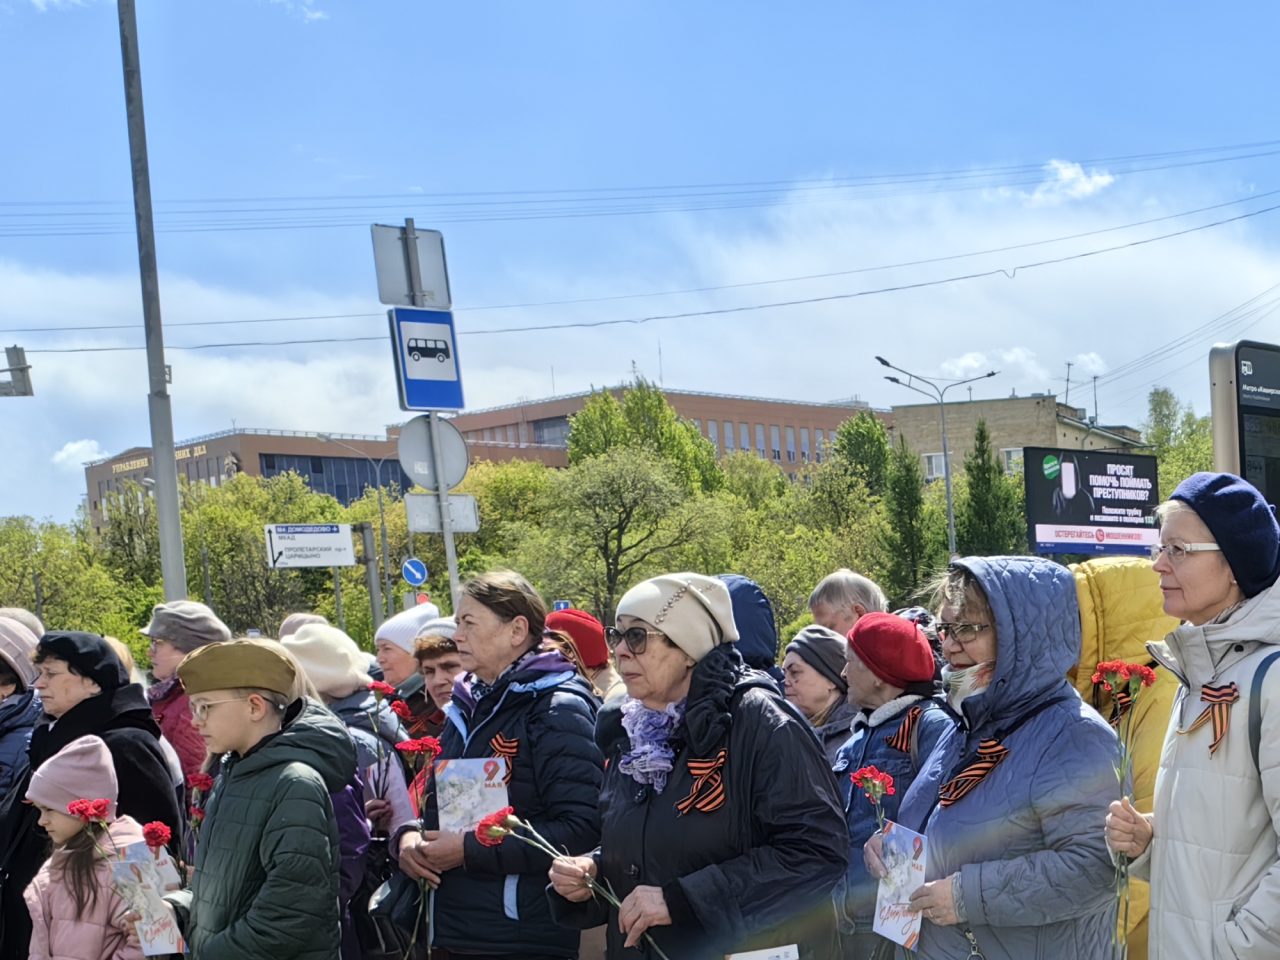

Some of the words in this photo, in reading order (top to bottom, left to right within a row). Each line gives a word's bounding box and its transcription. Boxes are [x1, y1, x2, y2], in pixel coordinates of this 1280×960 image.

[1107, 464, 1134, 476] ПРОСЯТ
[1089, 475, 1119, 487] ПОМОЧЬ
[1120, 476, 1152, 489] ПОЙМАТЬ
[1093, 487, 1149, 501] ПРЕСТУПНИКОВ?
